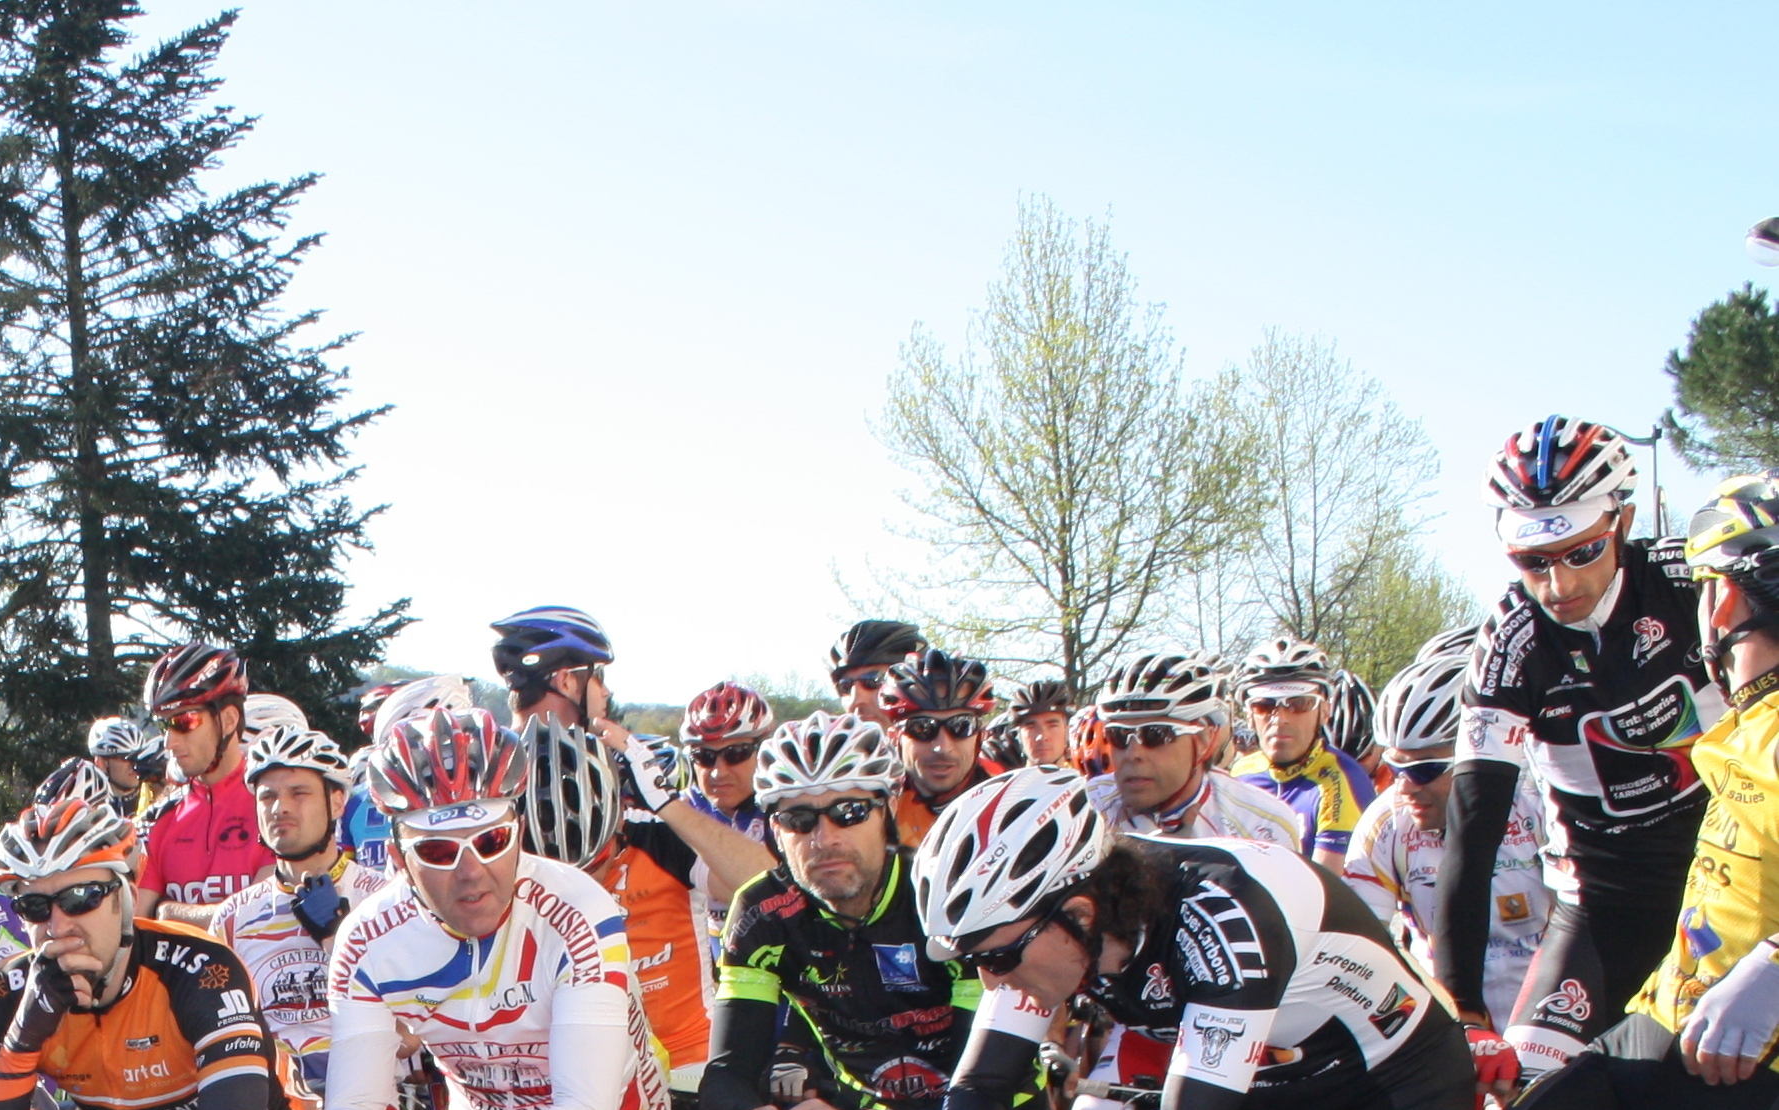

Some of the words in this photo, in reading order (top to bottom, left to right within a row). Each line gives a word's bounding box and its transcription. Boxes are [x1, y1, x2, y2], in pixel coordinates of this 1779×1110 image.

[1517, 521, 1544, 538] FDJ
[1617, 693, 1678, 729] Enteprise
[430, 810, 460, 824] FDJ
[1196, 924, 1231, 986] Carbone
[217, 989, 250, 1020] JD
[1325, 976, 1374, 1010] Peinture
